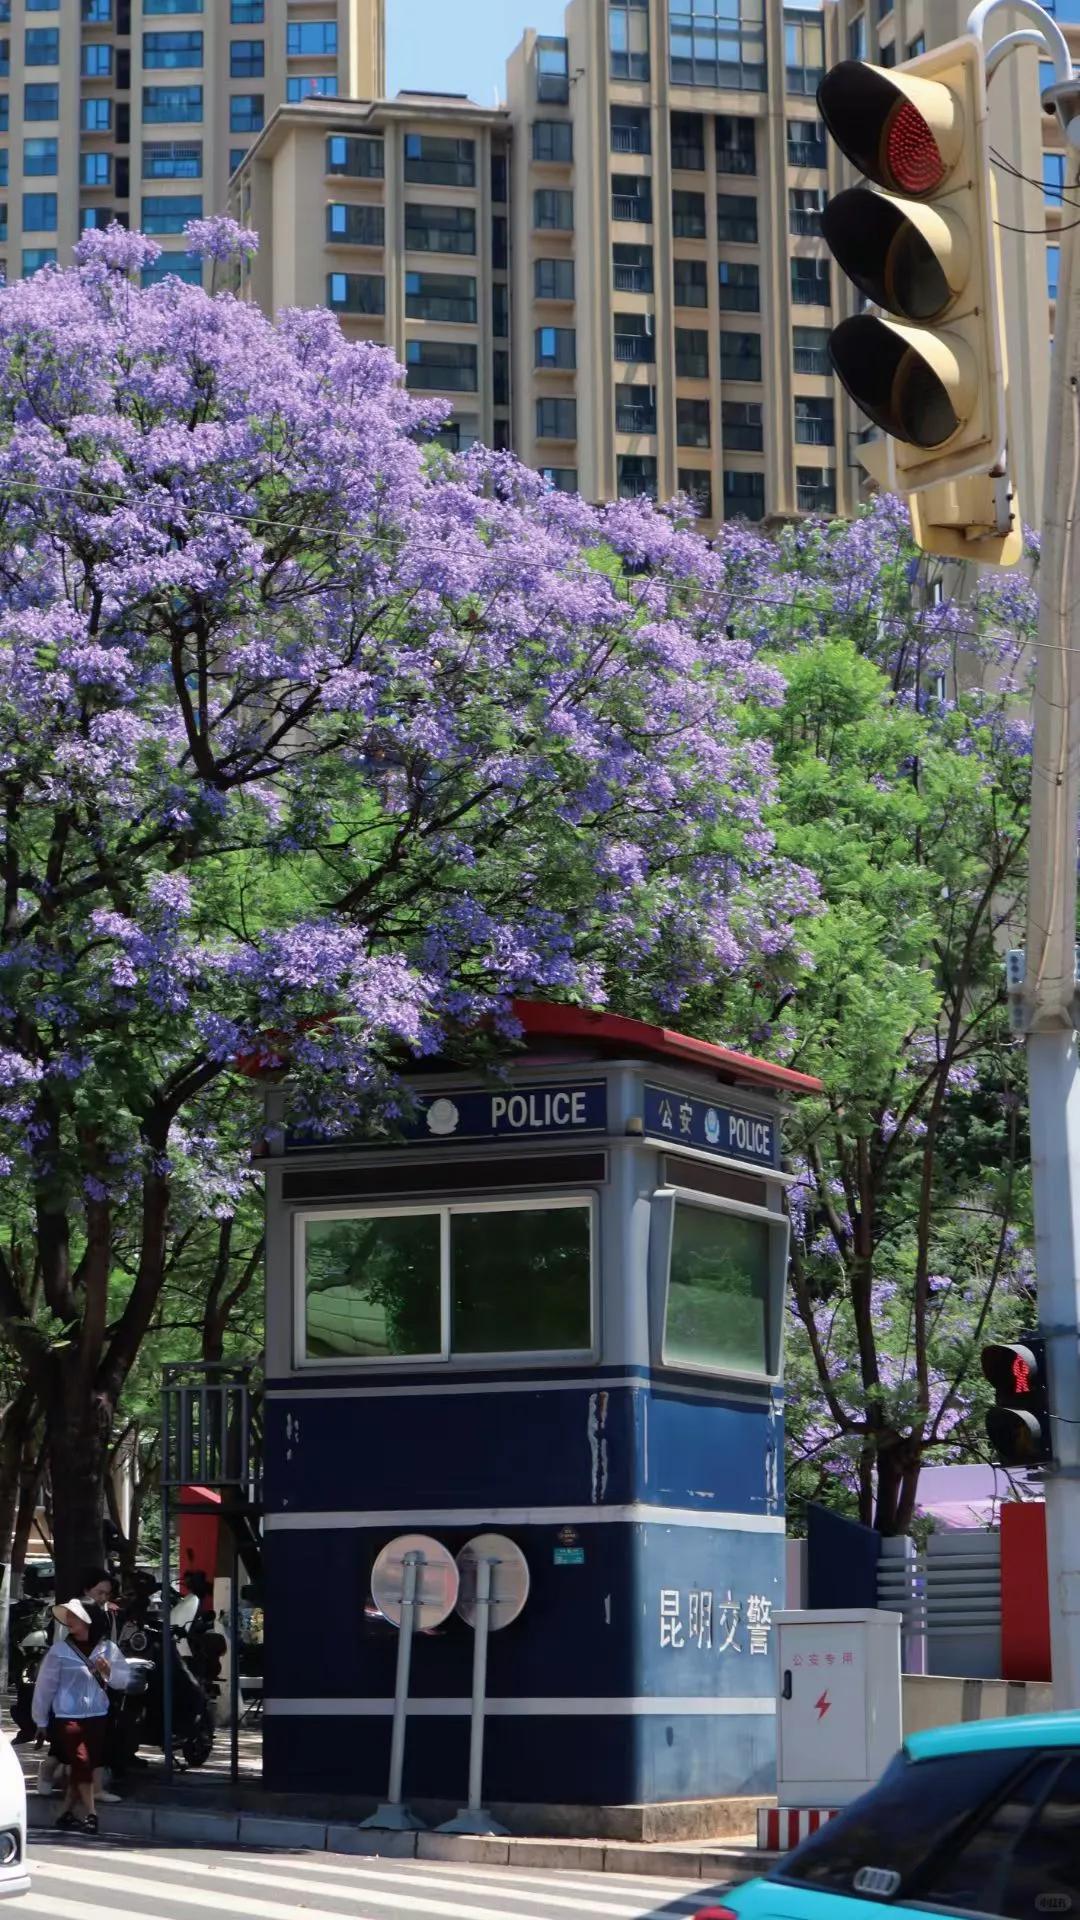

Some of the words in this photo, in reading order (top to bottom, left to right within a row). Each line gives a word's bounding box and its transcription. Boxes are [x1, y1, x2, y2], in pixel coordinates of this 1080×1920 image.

[491, 1091, 586, 1128] POLICE
[658, 1098, 693, 1135] 公安
[728, 1115, 770, 1156] POLICE
[660, 1589, 772, 1656] 昆明交警
[792, 1652, 854, 1666] 公安专用
